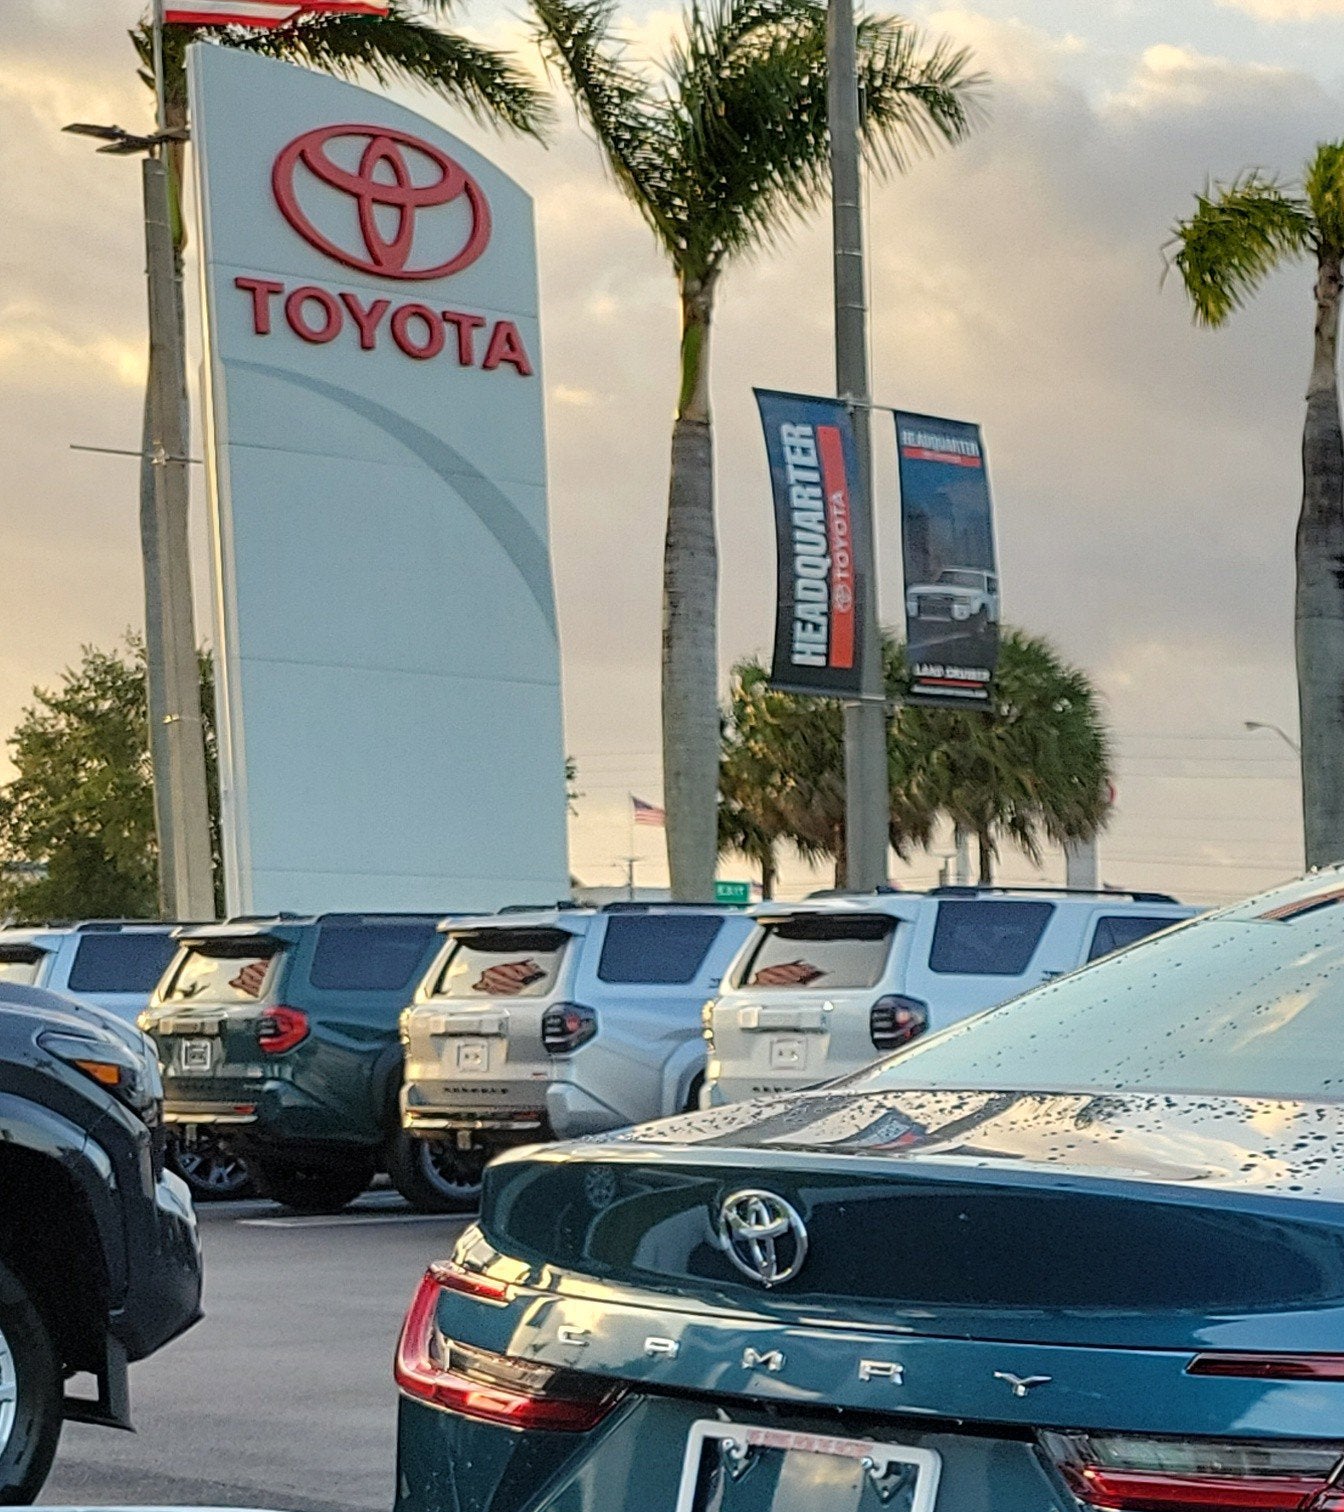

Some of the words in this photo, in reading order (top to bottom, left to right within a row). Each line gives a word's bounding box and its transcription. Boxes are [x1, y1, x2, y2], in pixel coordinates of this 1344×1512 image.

[234, 276, 534, 376] TOYOTA
[781, 423, 831, 666] HEADQUARTER
[830, 490, 850, 578] TOYOTA
[558, 1325, 1052, 1397] CAMRY
